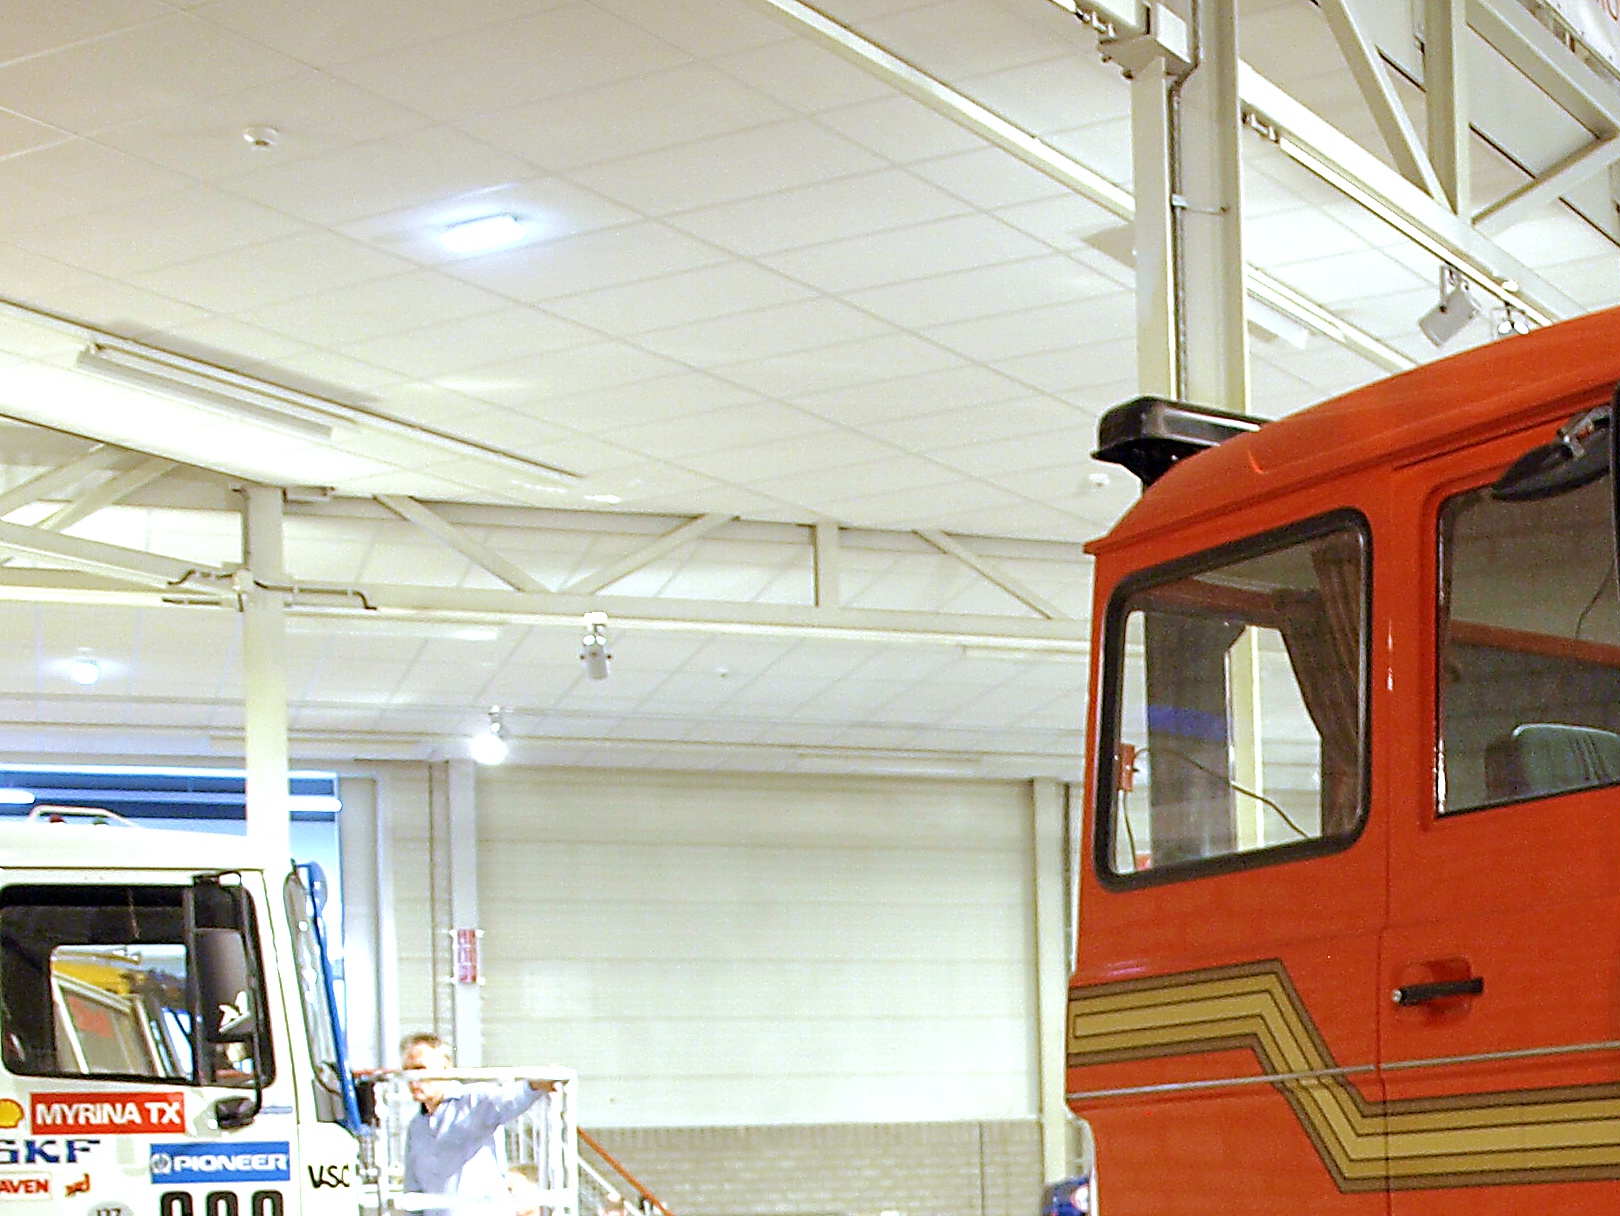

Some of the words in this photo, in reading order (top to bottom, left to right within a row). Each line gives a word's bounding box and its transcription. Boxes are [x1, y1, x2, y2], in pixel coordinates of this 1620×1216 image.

[36, 1102, 142, 1125] MYRINA
[144, 1101, 181, 1124] TX
[173, 1153, 289, 1172] PIONEER
